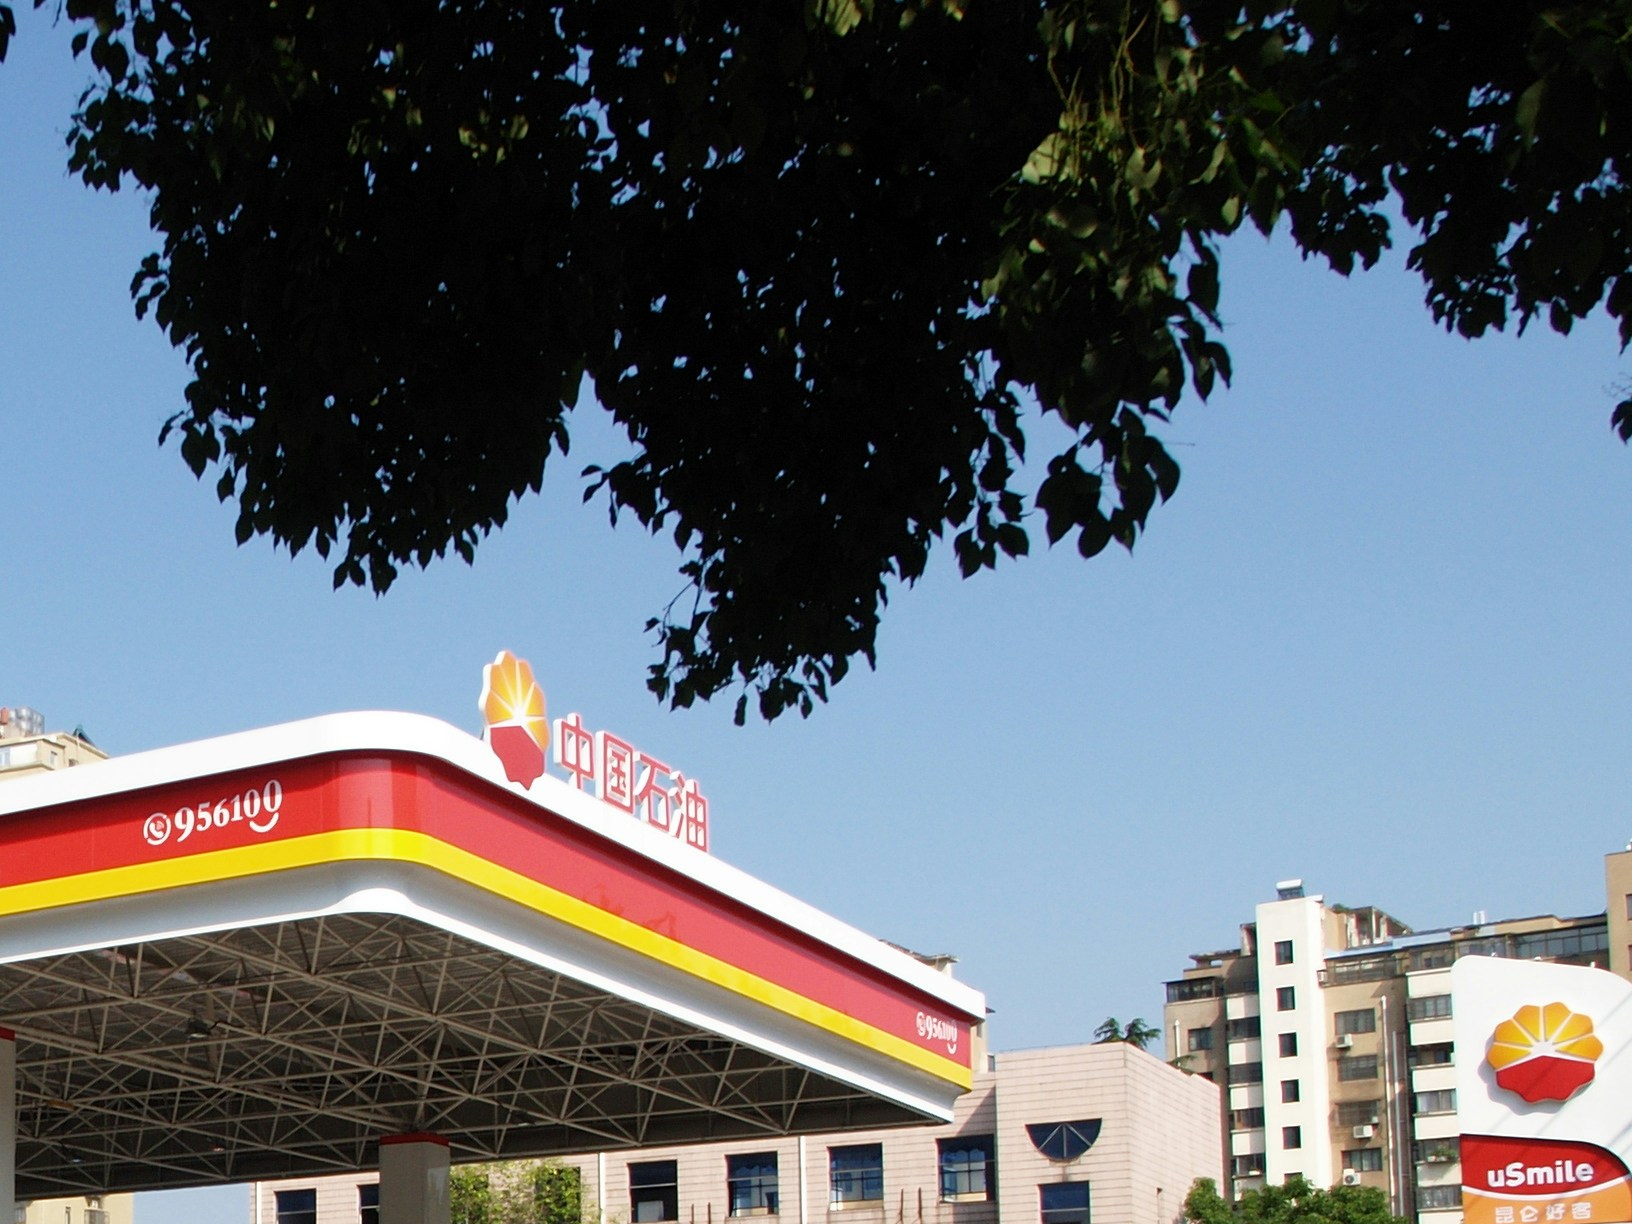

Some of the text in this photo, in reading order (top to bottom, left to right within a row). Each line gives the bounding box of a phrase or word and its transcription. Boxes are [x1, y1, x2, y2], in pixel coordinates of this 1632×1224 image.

[553, 712, 708, 852] 中国石油
[174, 780, 283, 842] 956100
[1487, 1160, 1594, 1187] uSmile
[1495, 1202, 1592, 1224] 昆仑好客
